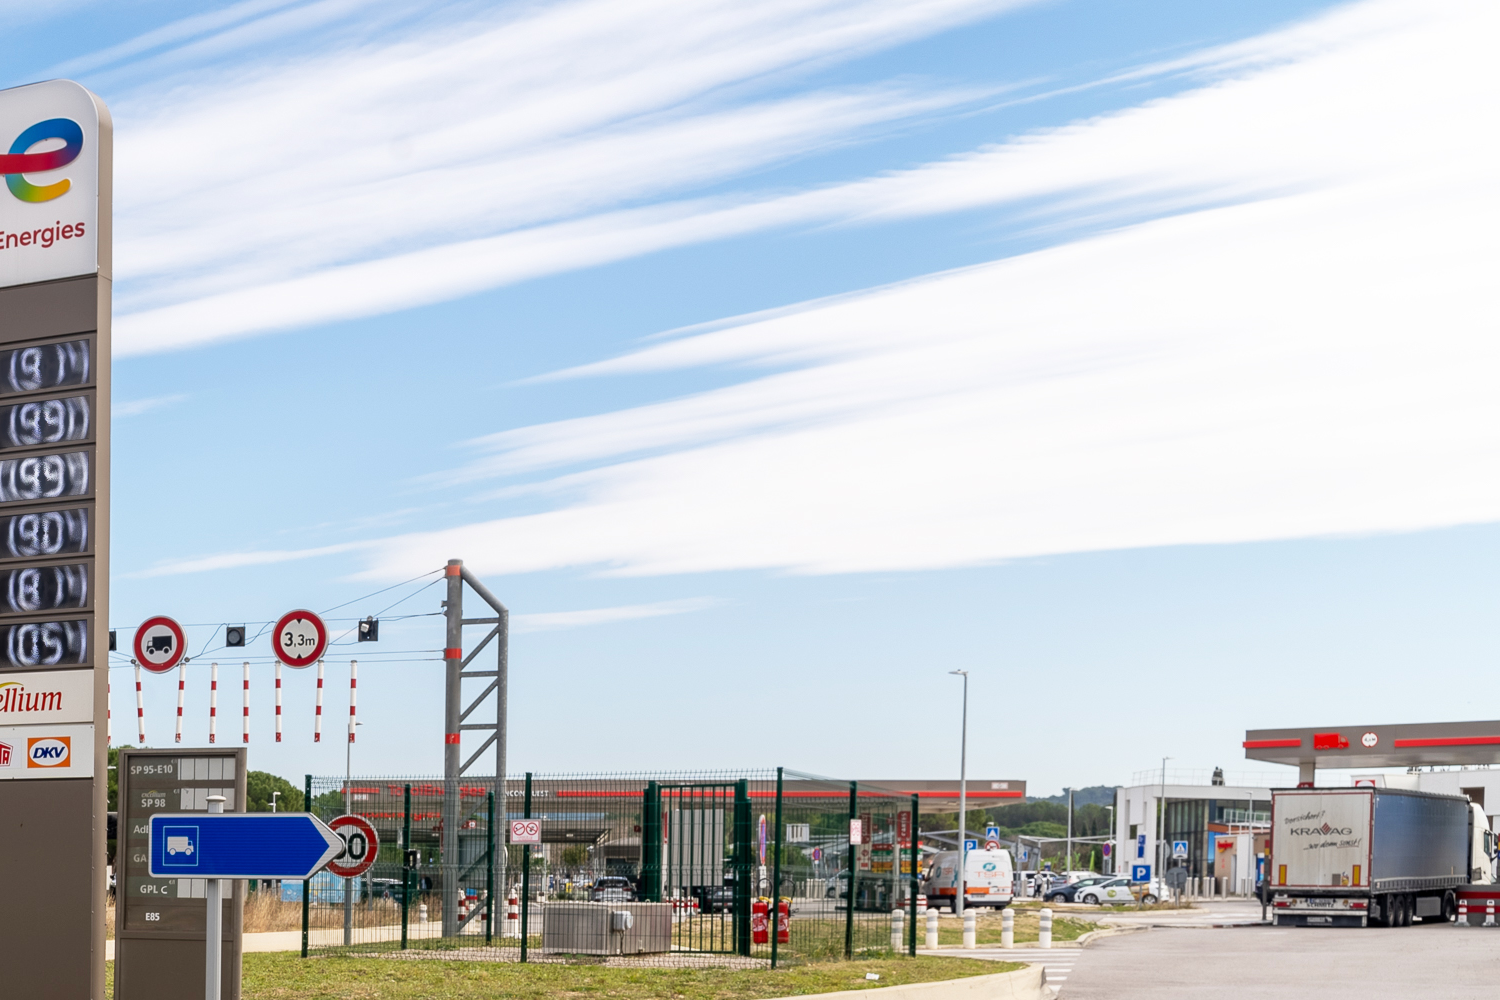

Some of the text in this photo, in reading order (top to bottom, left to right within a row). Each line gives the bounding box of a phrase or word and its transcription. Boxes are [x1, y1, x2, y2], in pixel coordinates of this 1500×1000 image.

[32, 746, 66, 759] DKV
[130, 764, 173, 774] SP 95-E10
[141, 798, 166, 807] SP 98
[1290, 827, 1353, 836] KRAVAG
[140, 885, 168, 894] GPL C
[145, 912, 160, 921] E85
